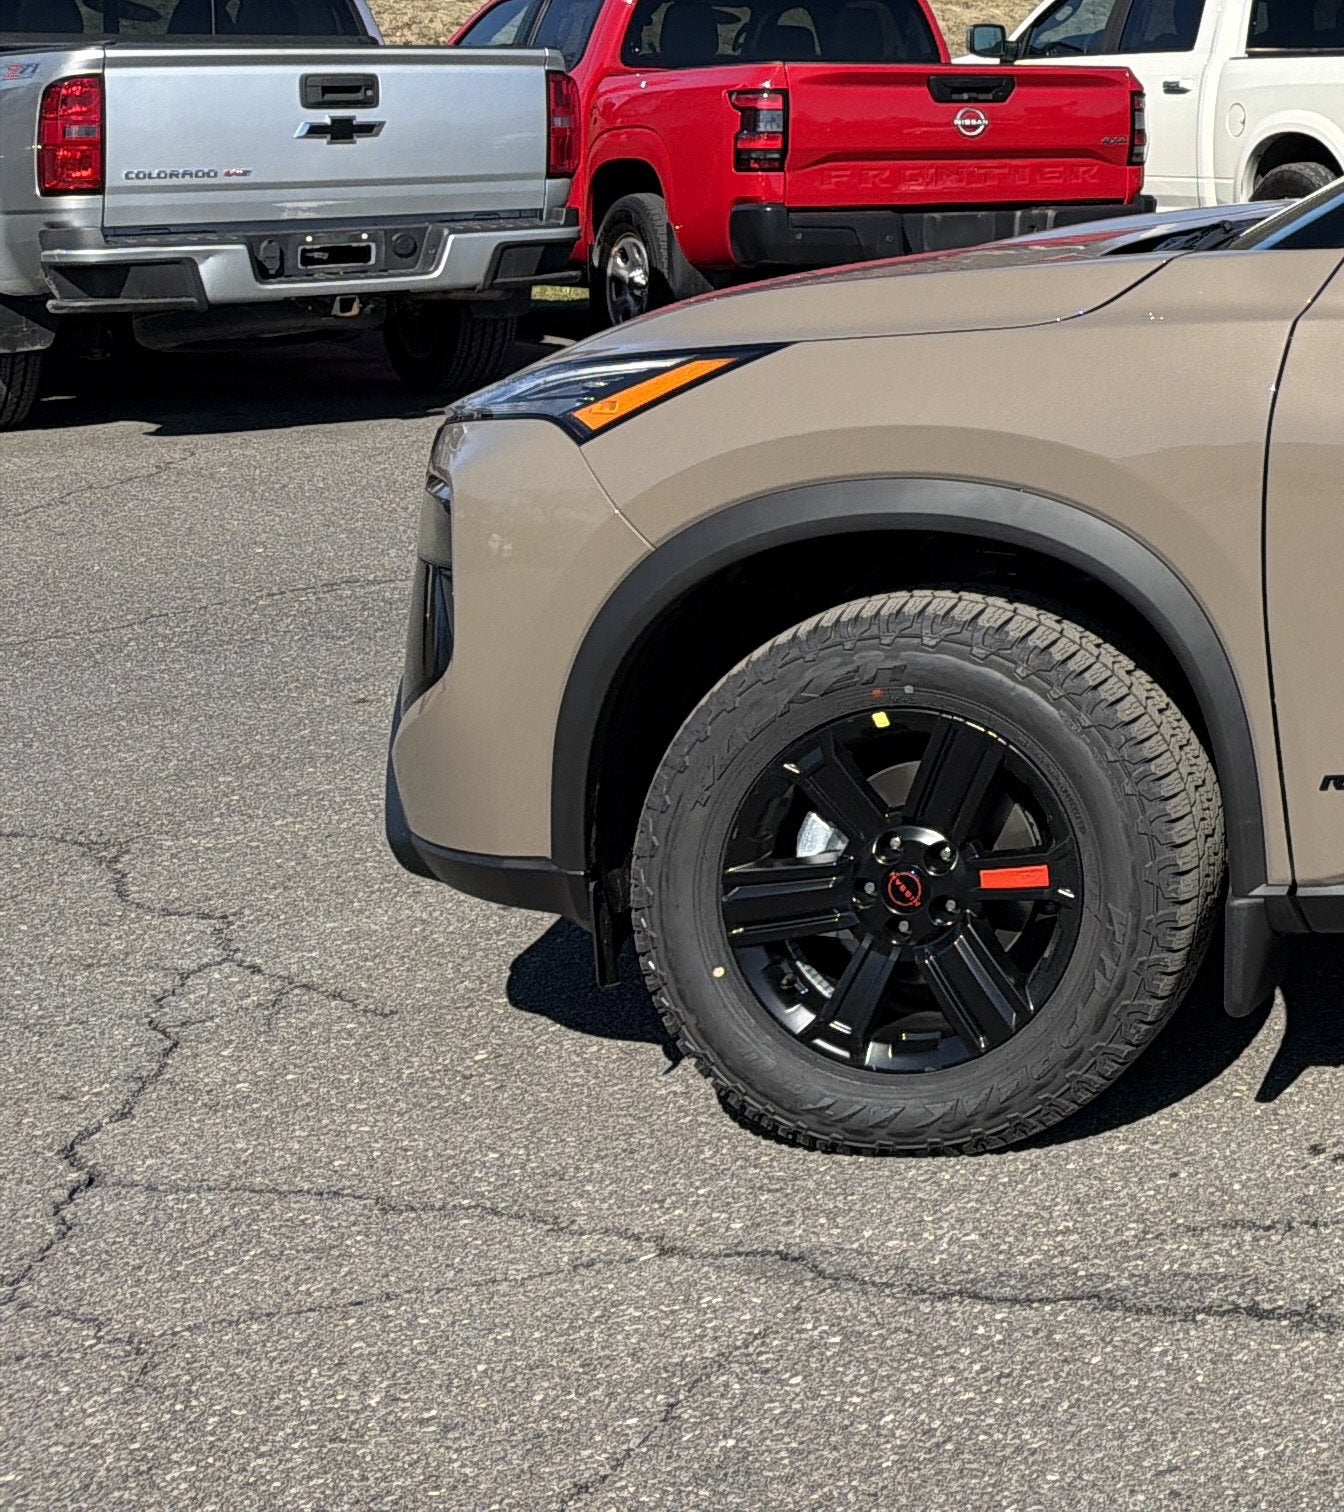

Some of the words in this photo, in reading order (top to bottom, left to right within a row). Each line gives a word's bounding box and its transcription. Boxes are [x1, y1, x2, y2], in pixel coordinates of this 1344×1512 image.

[953, 118, 989, 126] NISSAN
[123, 169, 218, 181] COLORADO
[819, 165, 1099, 188] FRONTIER
